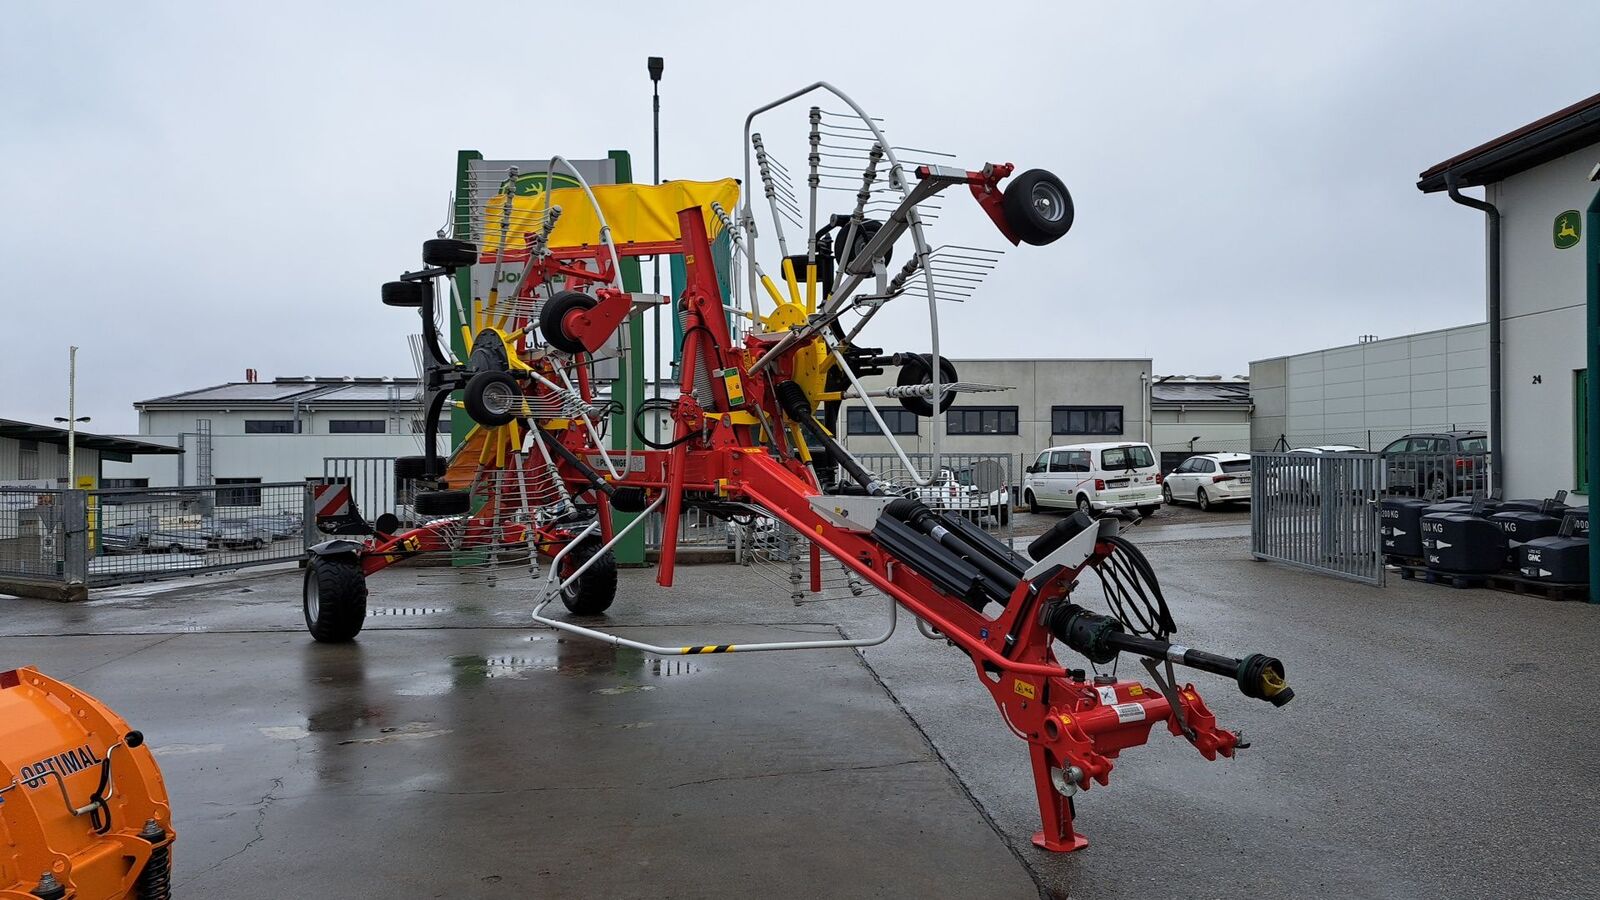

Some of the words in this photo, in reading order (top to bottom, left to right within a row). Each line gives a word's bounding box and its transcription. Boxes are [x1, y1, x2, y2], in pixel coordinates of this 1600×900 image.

[1532, 375, 1541, 384] 24
[1390, 510, 1399, 518] KG
[1432, 523, 1443, 533] KG
[1504, 522, 1517, 532] KG
[1527, 554, 1541, 562] GMC
[20, 744, 102, 789] OPTIMAL
